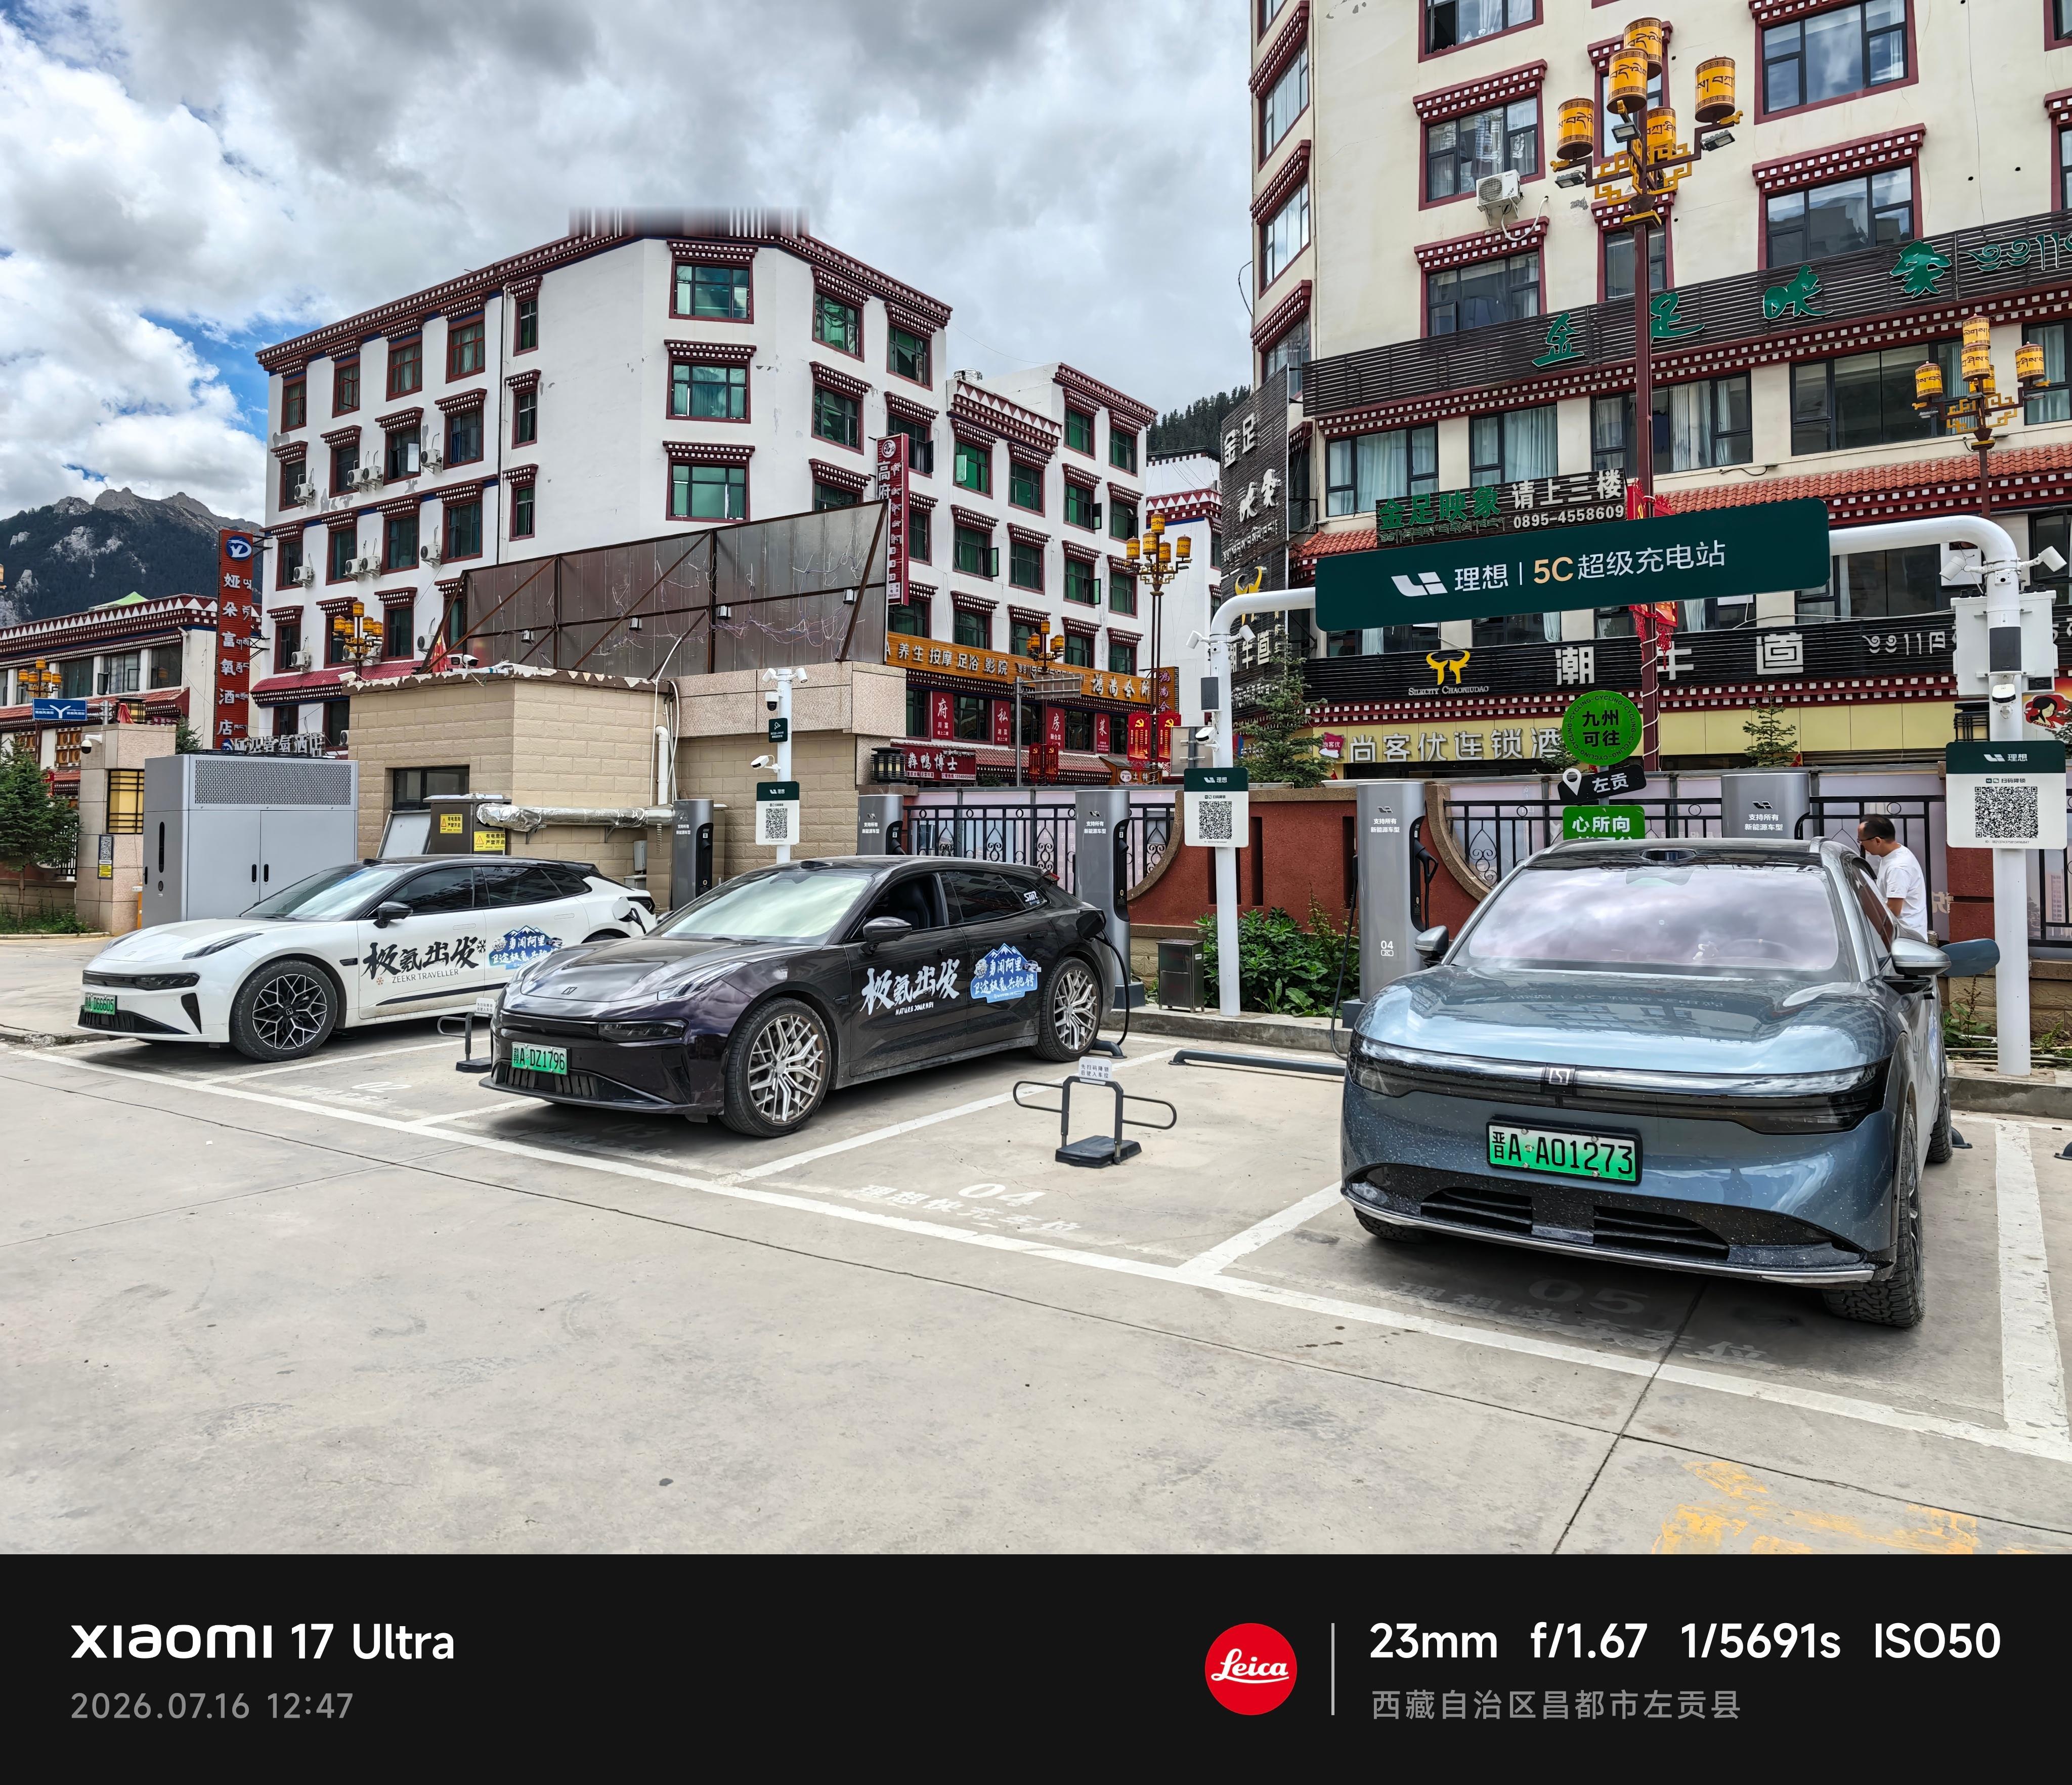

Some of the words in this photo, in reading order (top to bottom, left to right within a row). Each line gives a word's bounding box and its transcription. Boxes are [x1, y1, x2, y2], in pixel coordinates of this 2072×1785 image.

[1224, 412, 1260, 469] 金足
[877, 460, 890, 499] 高府
[1378, 485, 1501, 531] 金足映象
[1512, 469, 1621, 509] 请上三楼
[1514, 504, 1624, 529] 0895-4558609
[1454, 563, 1508, 591] 理想
[217, 573, 241, 736] 娅朵富氧酒店
[898, 642, 924, 662] 养生
[929, 648, 953, 666] 按摩
[957, 653, 979, 671] 足浴
[984, 657, 1008, 675] 影院
[1442, 686, 1489, 695] CHAONIUDAO
[938, 698, 948, 719] 府
[997, 707, 1008, 724] 私
[1582, 709, 1619, 727] 九州
[1052, 713, 1060, 731] 房
[1099, 718, 1107, 736] 菜
[1582, 730, 1620, 747] 可往
[2007, 754, 2028, 762] 理想
[1592, 773, 1629, 793] 左贡
[1572, 816, 1630, 833] 心所向
[508, 935, 545, 951] 勇闯阿里
[1380, 941, 1394, 950] 04
[392, 973, 416, 984] ZEEKR
[417, 968, 459, 980] TRAVELLER
[988, 956, 1021, 977] 勇闯阿里
[895, 1006, 914, 1016] NATURE
[914, 1001, 934, 1012] JOURNEY
[958, 1183, 1047, 1207] 04
[1528, 1279, 1651, 1314] 05
